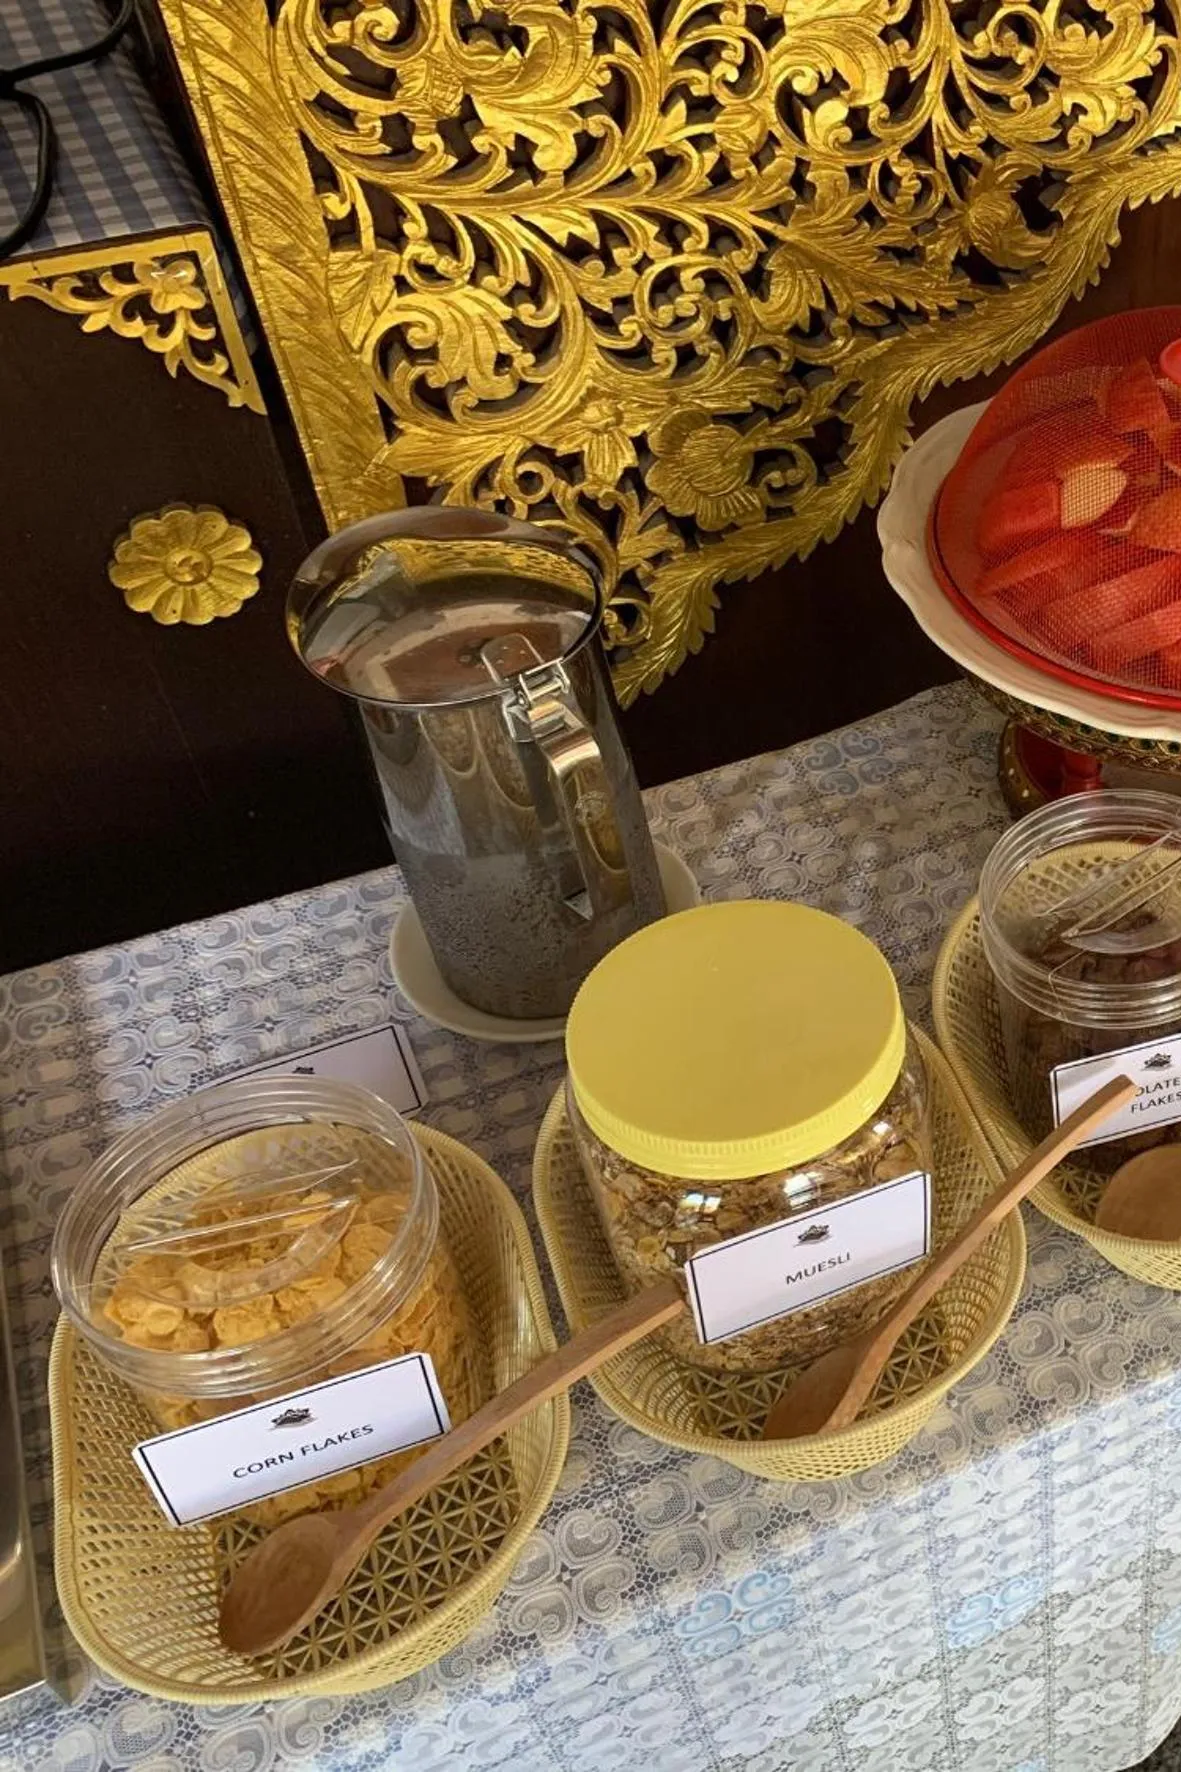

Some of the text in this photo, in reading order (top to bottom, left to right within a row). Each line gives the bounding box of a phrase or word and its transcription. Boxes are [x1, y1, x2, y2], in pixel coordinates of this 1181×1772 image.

[1134, 1076, 1181, 1097] OLATE
[785, 1251, 852, 1285] MUESLI
[232, 1424, 374, 1479] CORN FLAKES
